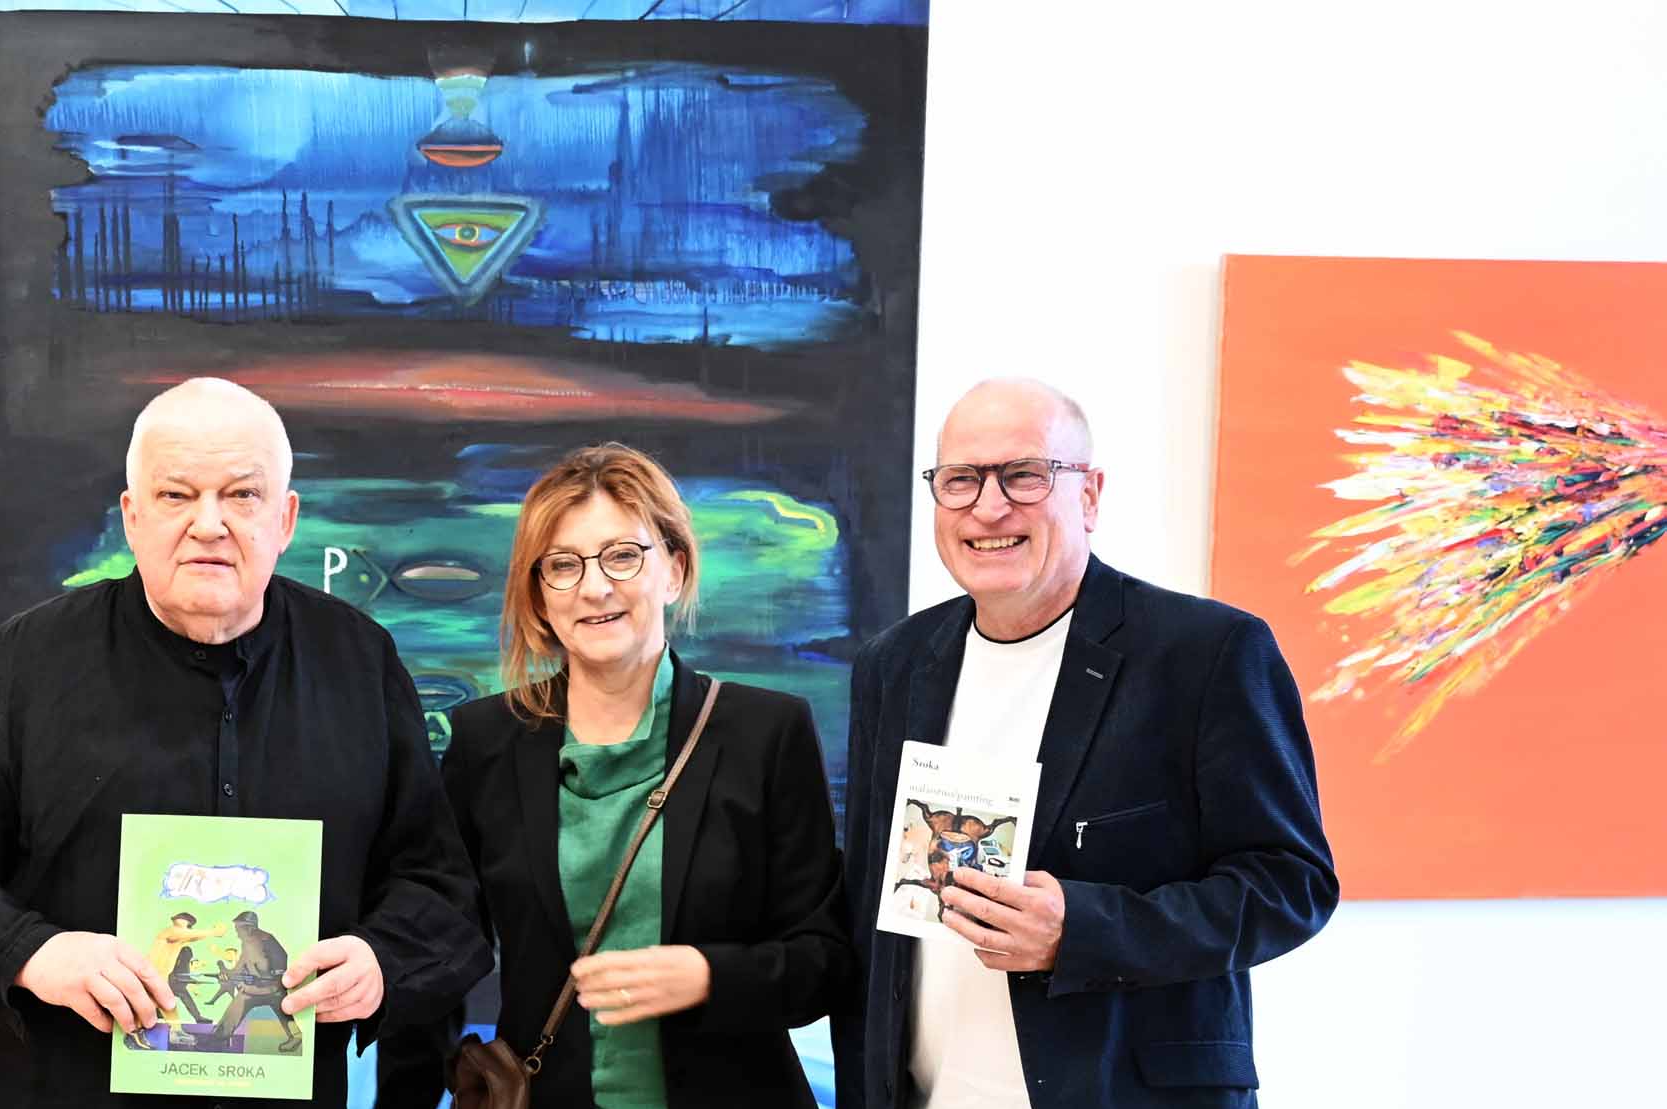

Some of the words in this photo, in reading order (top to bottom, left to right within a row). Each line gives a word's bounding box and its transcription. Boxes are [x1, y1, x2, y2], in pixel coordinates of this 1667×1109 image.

[911, 758, 940, 771] Sroka
[160, 1062, 208, 1077] JACEK
[217, 1064, 266, 1079] SROKA
